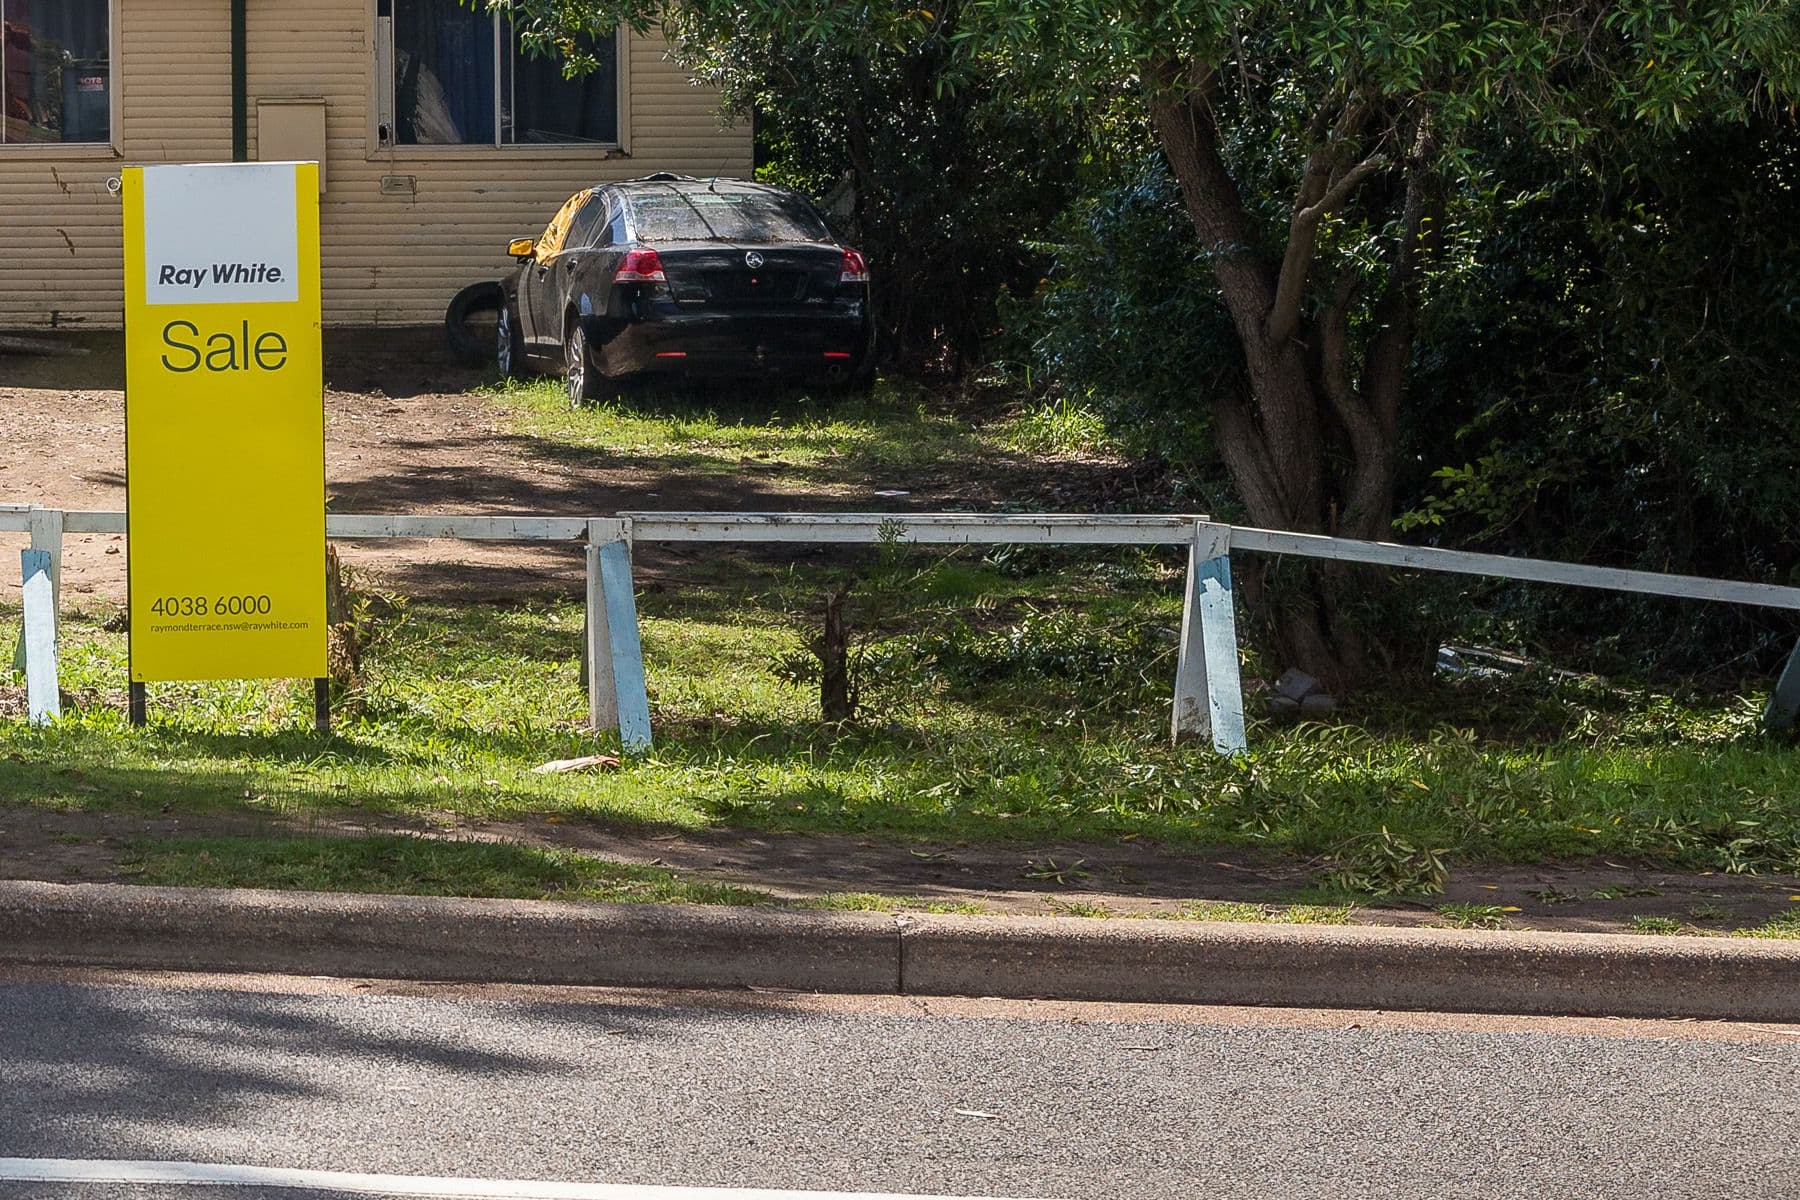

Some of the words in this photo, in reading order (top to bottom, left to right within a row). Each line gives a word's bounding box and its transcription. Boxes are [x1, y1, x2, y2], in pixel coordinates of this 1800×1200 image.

[158, 264, 208, 289] Ray
[161, 319, 288, 373] Sale
[151, 596, 208, 617] 4038
[214, 595, 271, 616] 6000
[150, 620, 309, 633] raymondterrace.nsw@raywhite.com
